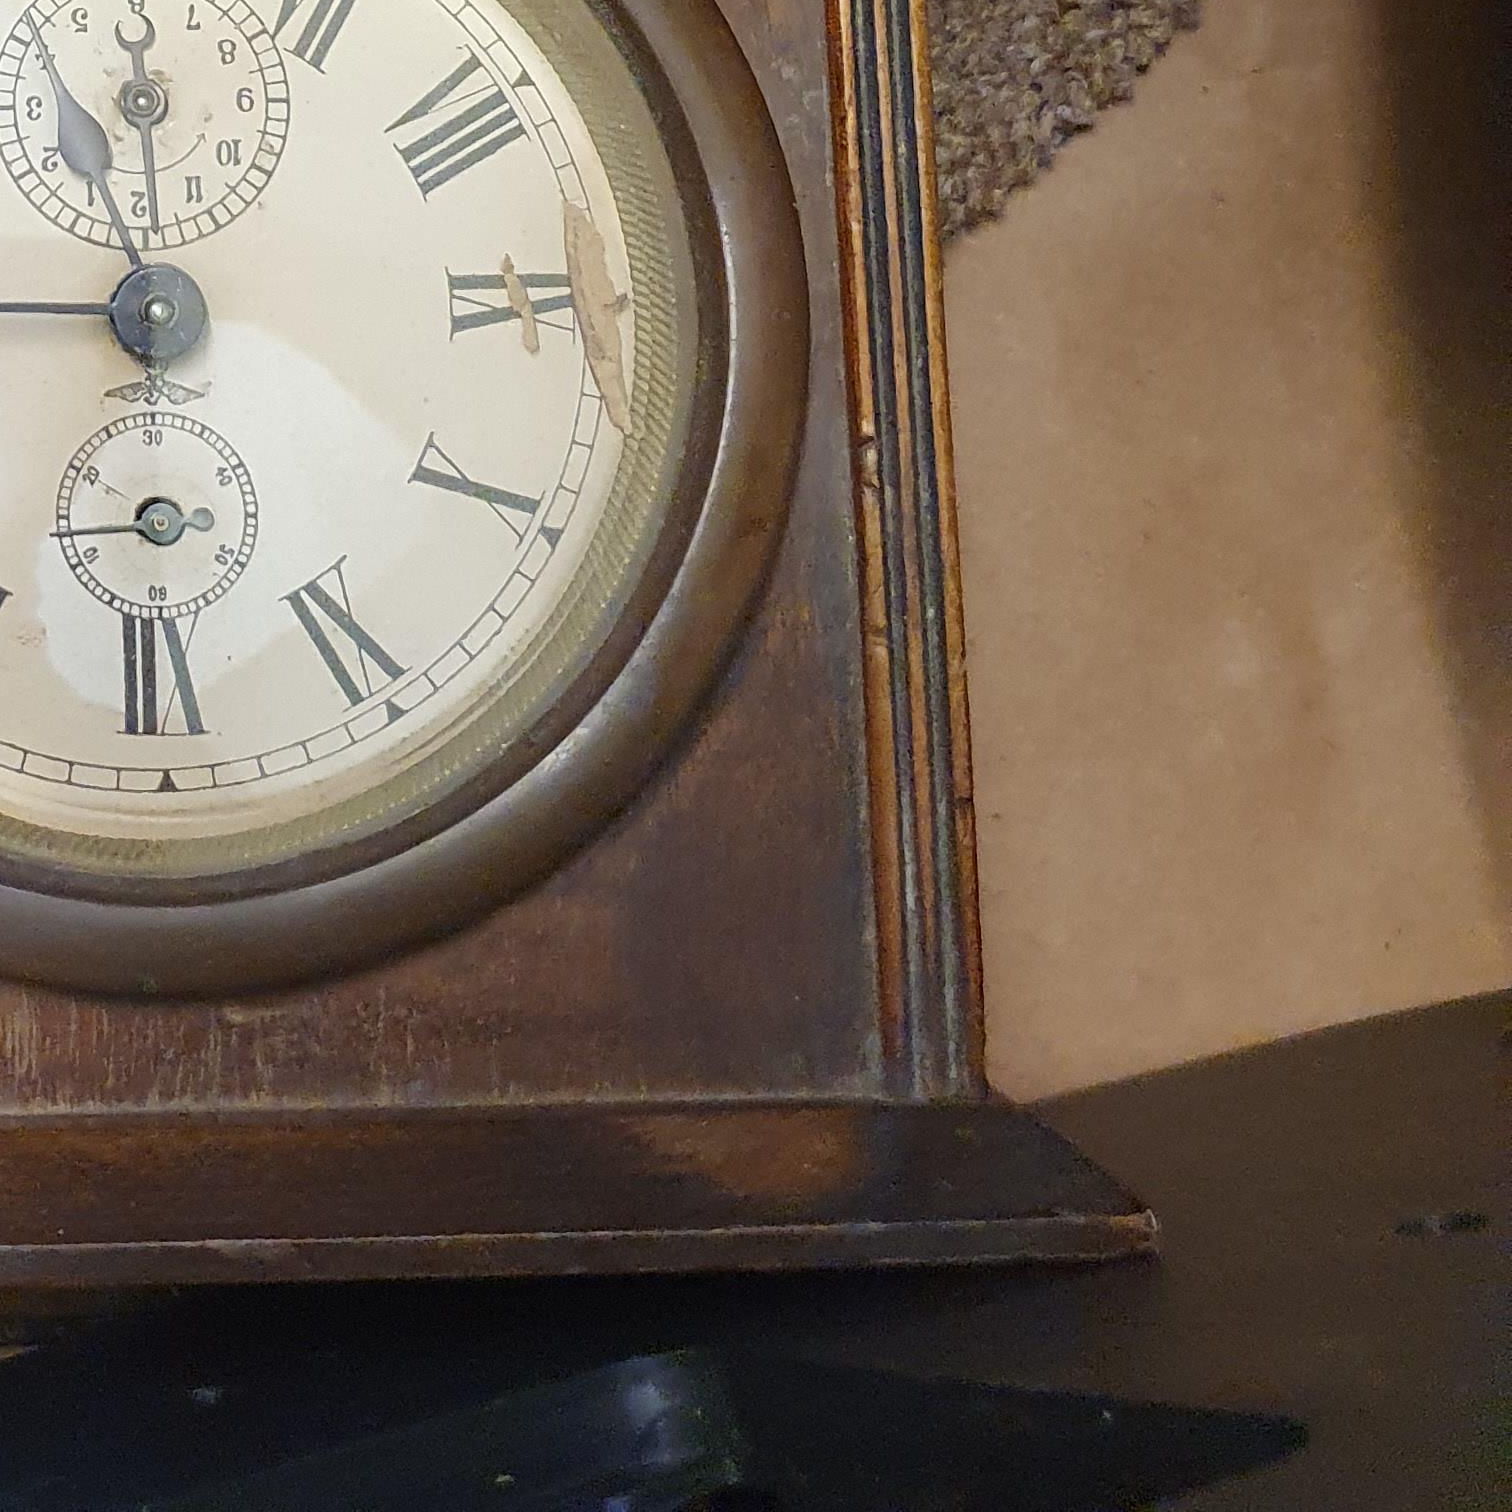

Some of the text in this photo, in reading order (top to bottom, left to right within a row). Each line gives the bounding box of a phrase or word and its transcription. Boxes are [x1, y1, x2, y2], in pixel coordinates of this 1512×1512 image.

[71, 7, 89, 33] 5
[187, 5, 201, 31] 7
[218, 39, 236, 65] 8
[25, 96, 43, 120] 3
[235, 88, 254, 112] 9
[384, 44, 532, 202] VIII
[42, 146, 61, 172] 2
[217, 139, 243, 167] 10
[184, 176, 204, 204] 11
[142, 429, 164, 446] 30
[82, 465, 100, 486] 20
[215, 466, 232, 486] 40
[407, 433, 545, 545] X
[82, 545, 100, 564] 10
[215, 543, 235, 566] 50
[279, 557, 411, 708] XI
[117, 615, 210, 736] XII
